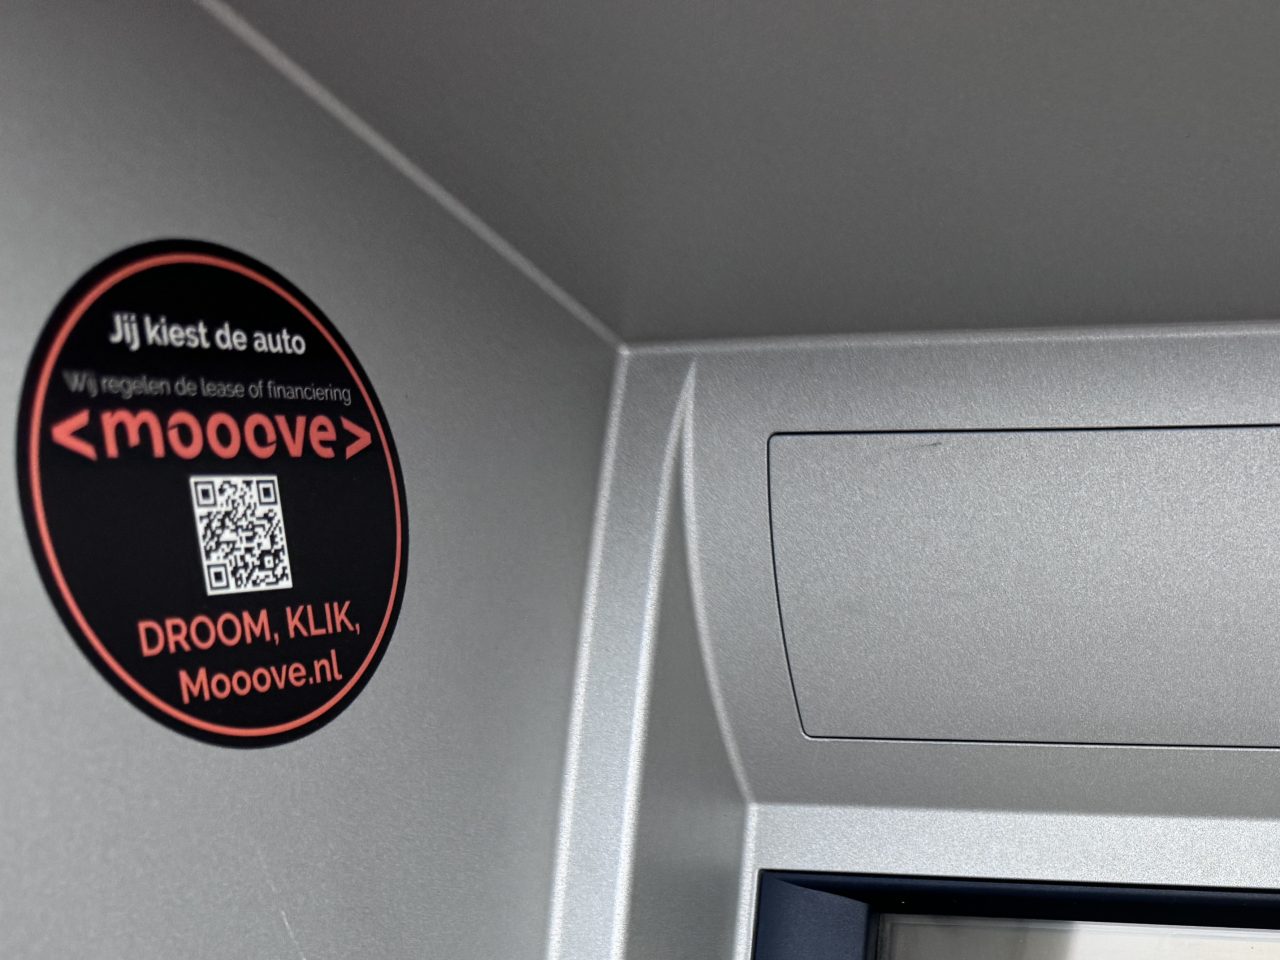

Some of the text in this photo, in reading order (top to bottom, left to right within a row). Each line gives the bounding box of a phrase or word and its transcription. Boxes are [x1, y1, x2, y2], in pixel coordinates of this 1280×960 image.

[109, 310, 306, 355] Jij kiest de auto
[63, 369, 352, 406] Wij regelen de lease of financiering
[137, 600, 361, 657] DROOM, KLIK,
[178, 648, 343, 705] Mooove.nl
